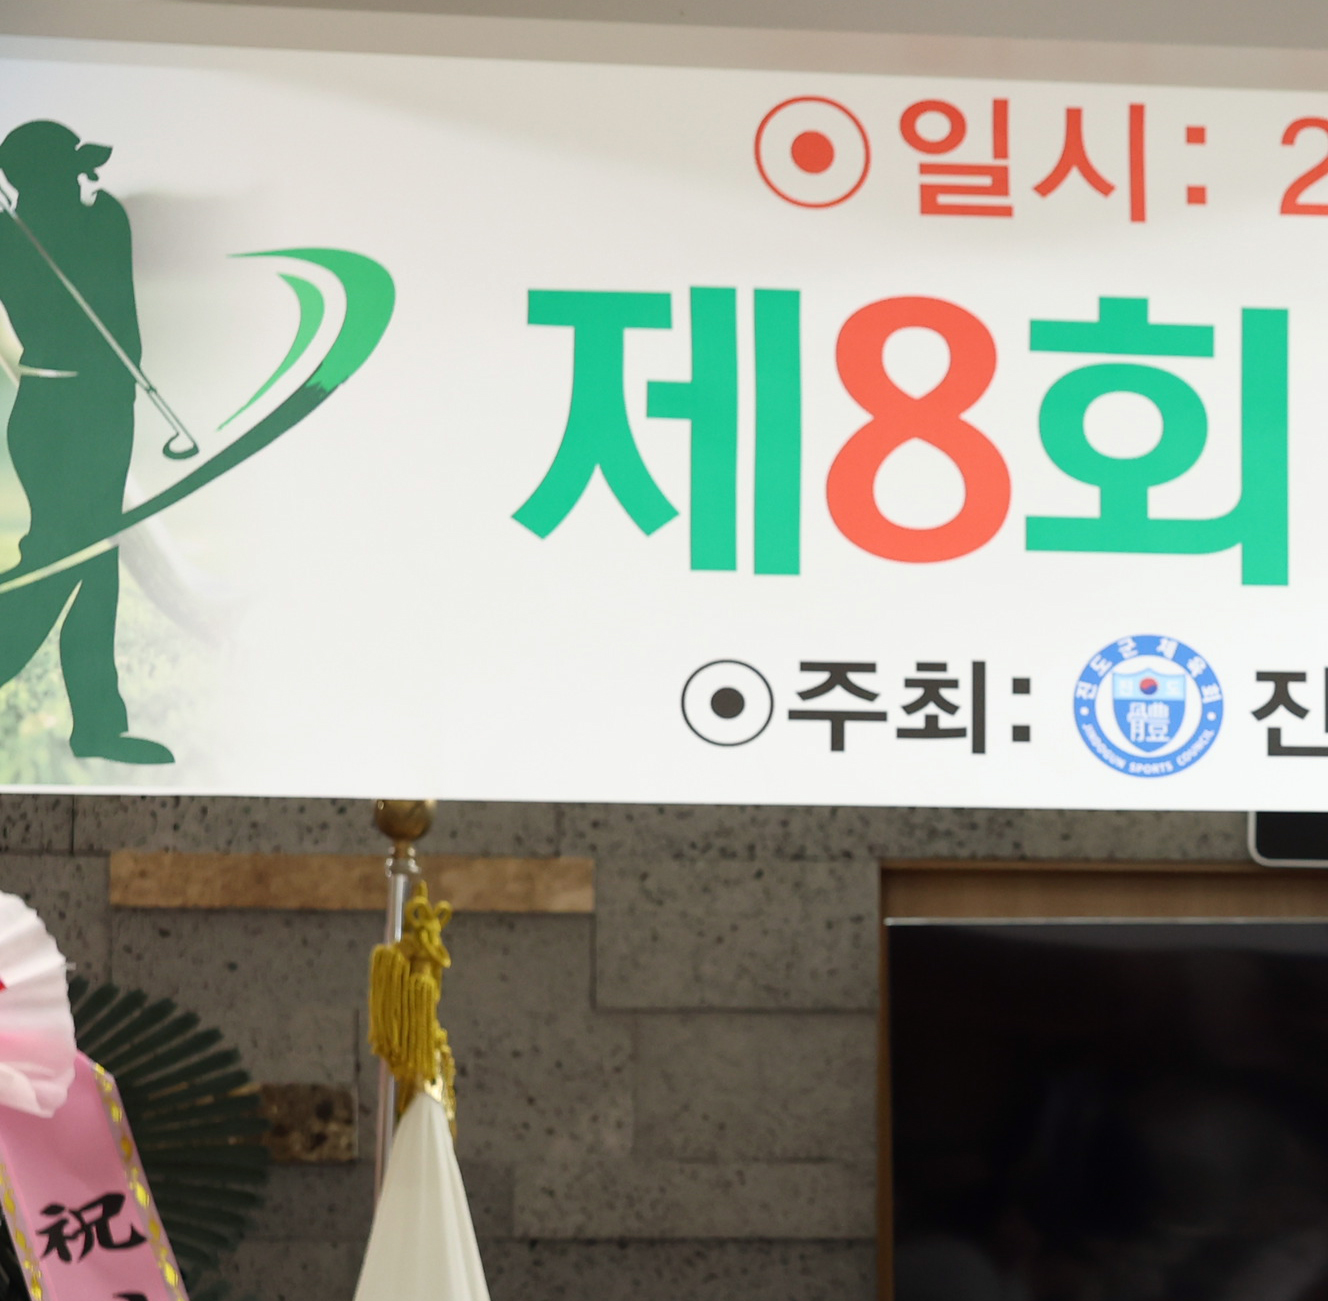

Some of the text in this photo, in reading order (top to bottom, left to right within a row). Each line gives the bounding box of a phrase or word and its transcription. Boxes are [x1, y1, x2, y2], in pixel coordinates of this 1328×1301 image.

[899, 98, 1206, 222] 일시:
[512, 286, 1288, 586] 제8회
[788, 661, 1030, 754] 주최:
[35, 1192, 148, 1264] 祝
